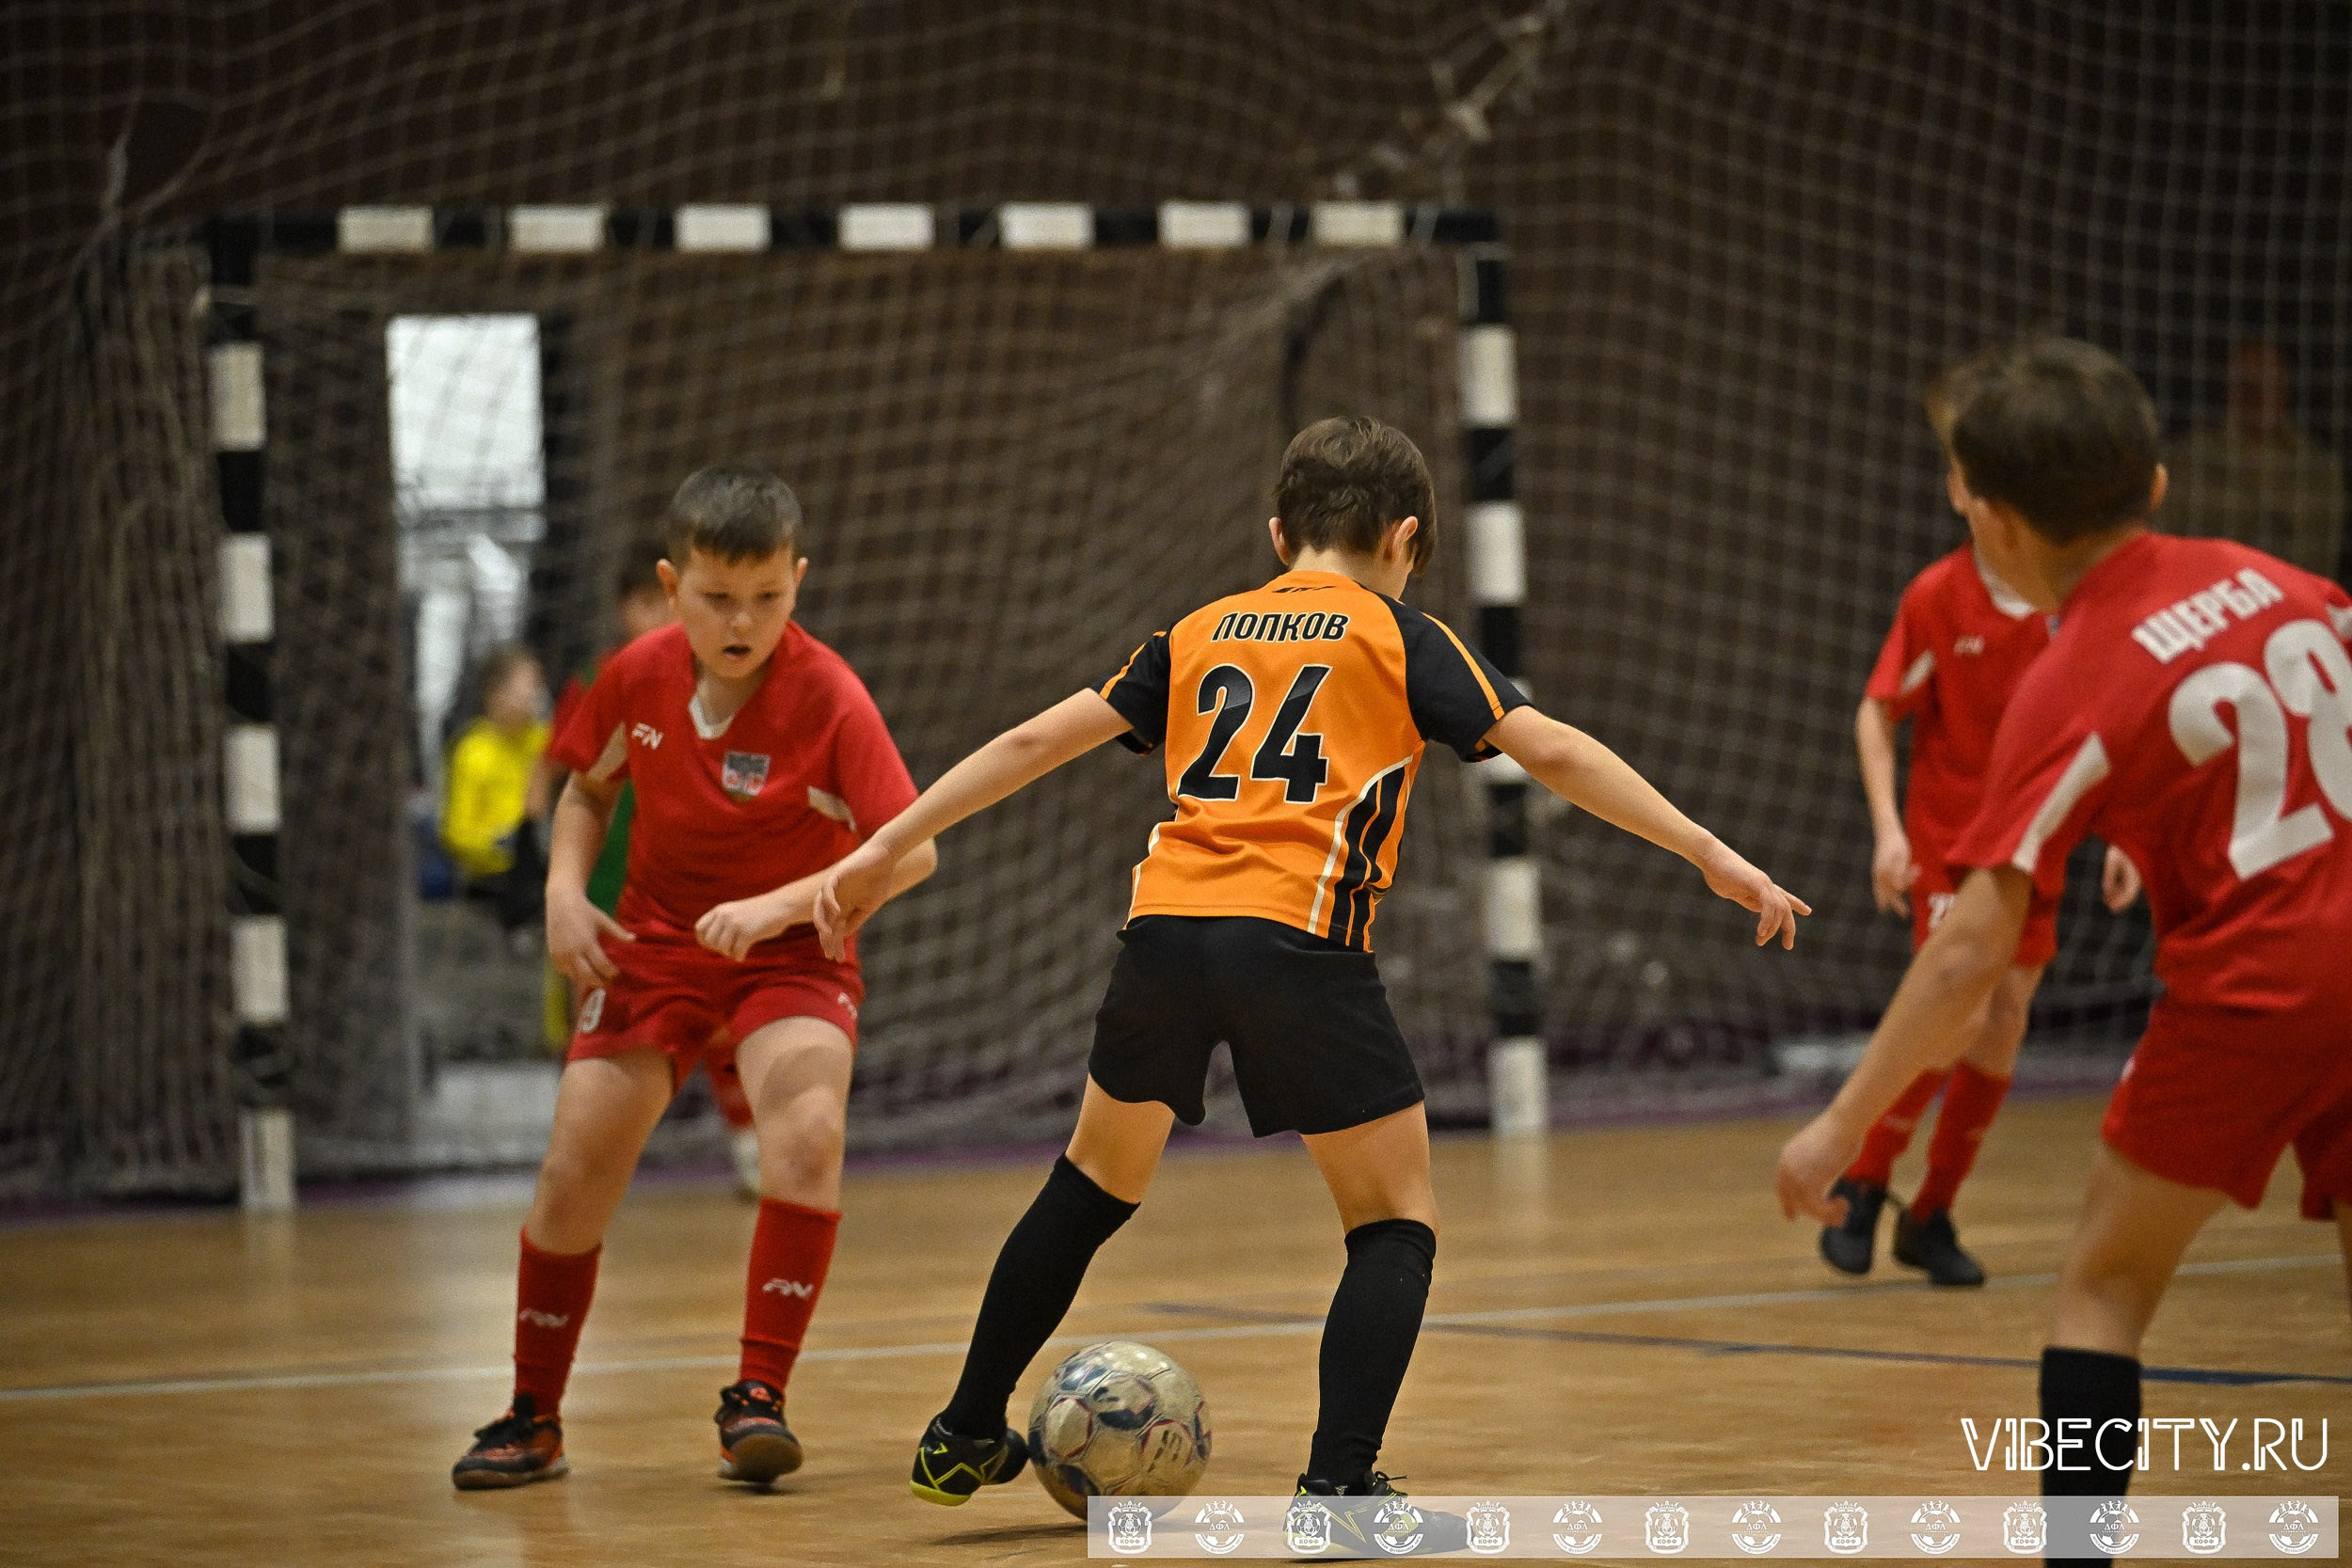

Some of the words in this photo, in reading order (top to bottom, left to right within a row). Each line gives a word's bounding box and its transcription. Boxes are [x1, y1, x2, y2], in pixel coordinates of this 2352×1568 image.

[2130, 567, 2285, 664] ЩЕРБА
[1176, 663, 1333, 804] 24
[2168, 618, 2352, 881] 28
